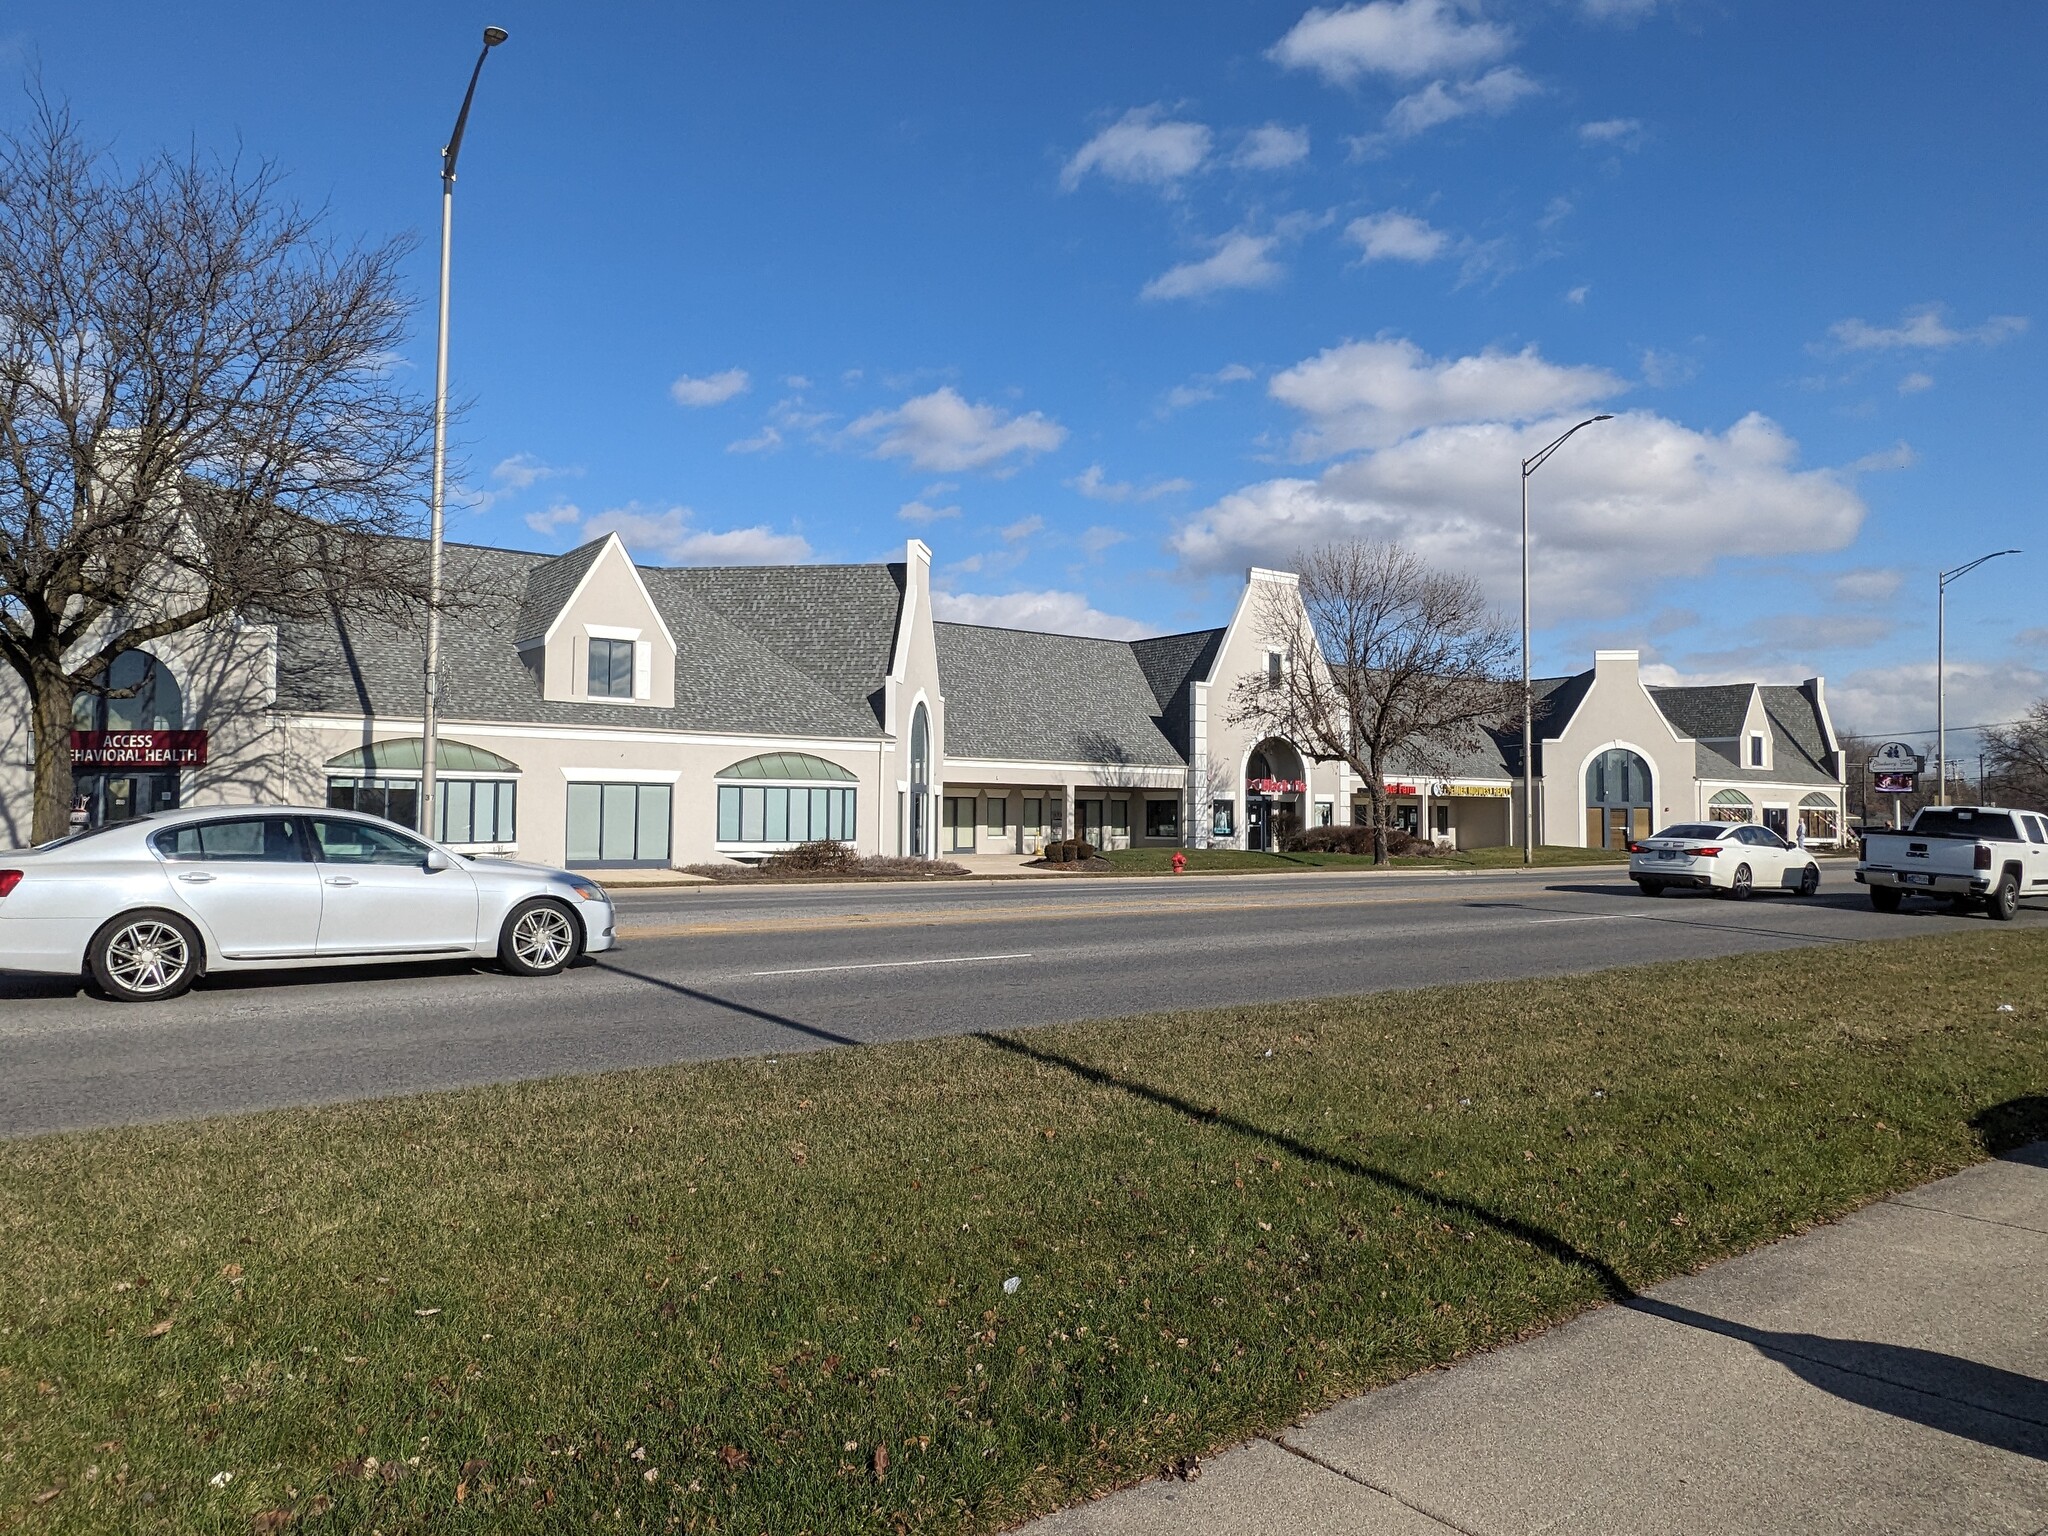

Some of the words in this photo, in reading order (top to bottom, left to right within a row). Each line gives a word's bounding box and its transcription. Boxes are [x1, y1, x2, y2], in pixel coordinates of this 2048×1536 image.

[103, 735, 153, 748] ACCESS
[70, 749, 142, 762] EHAVIORAL
[145, 749, 198, 762] HEALTH
[1397, 782, 1416, 795] Farm
[1906, 851, 1930, 859] GMC
